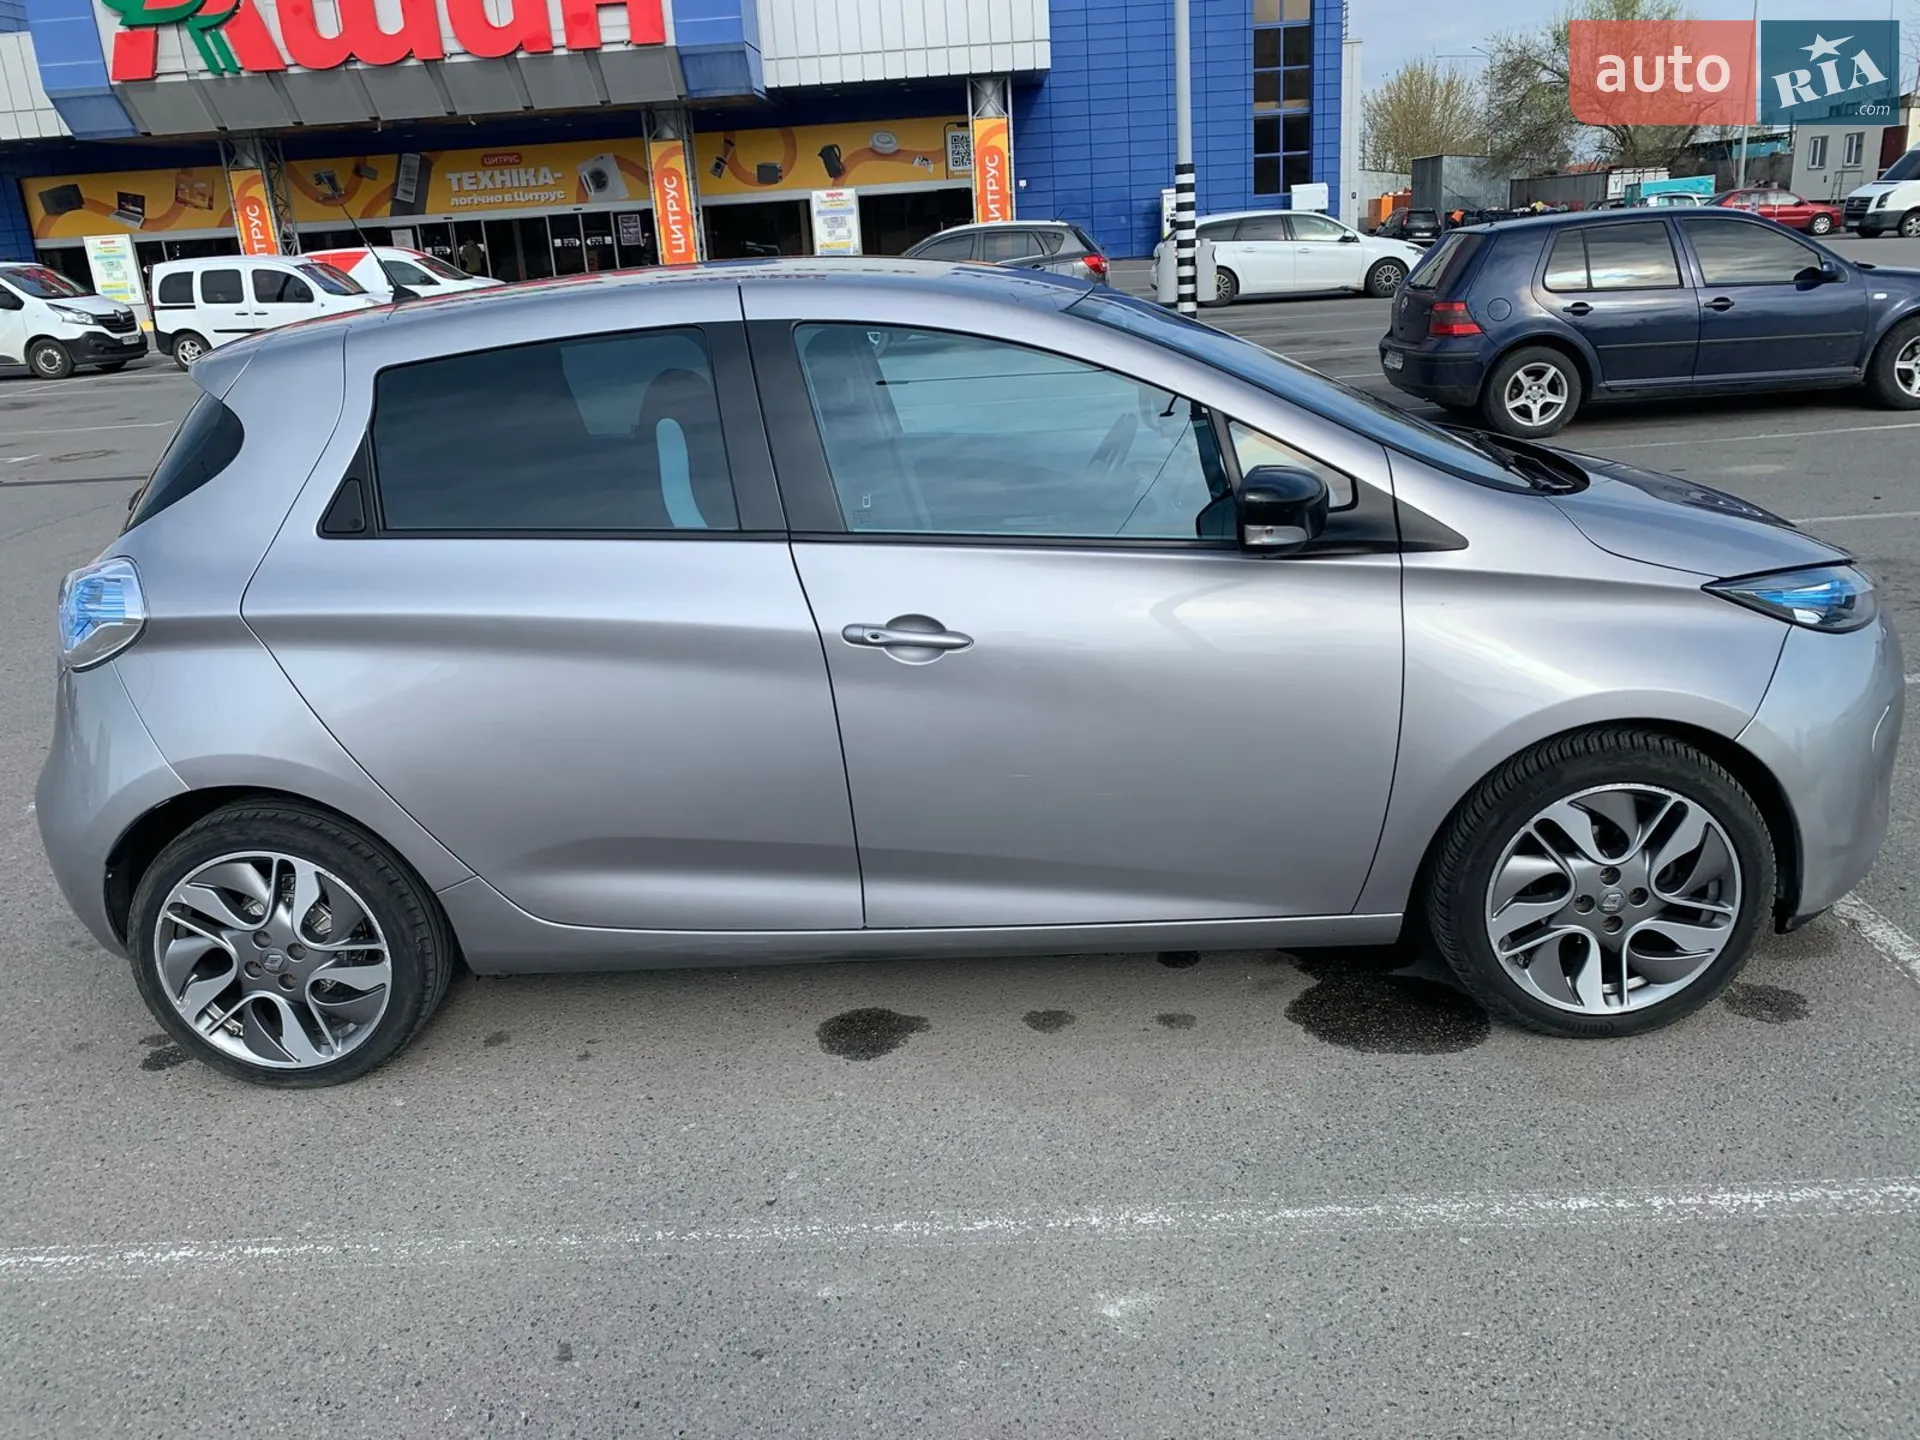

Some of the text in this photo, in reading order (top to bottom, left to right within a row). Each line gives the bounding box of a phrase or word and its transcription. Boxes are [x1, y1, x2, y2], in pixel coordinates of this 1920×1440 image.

[484, 155, 520, 165] ЦИТРУС
[451, 190, 565, 206] логічно в Цитрус
[663, 175, 686, 254] ЦИТРУС
[245, 204, 268, 256] ТРУС
